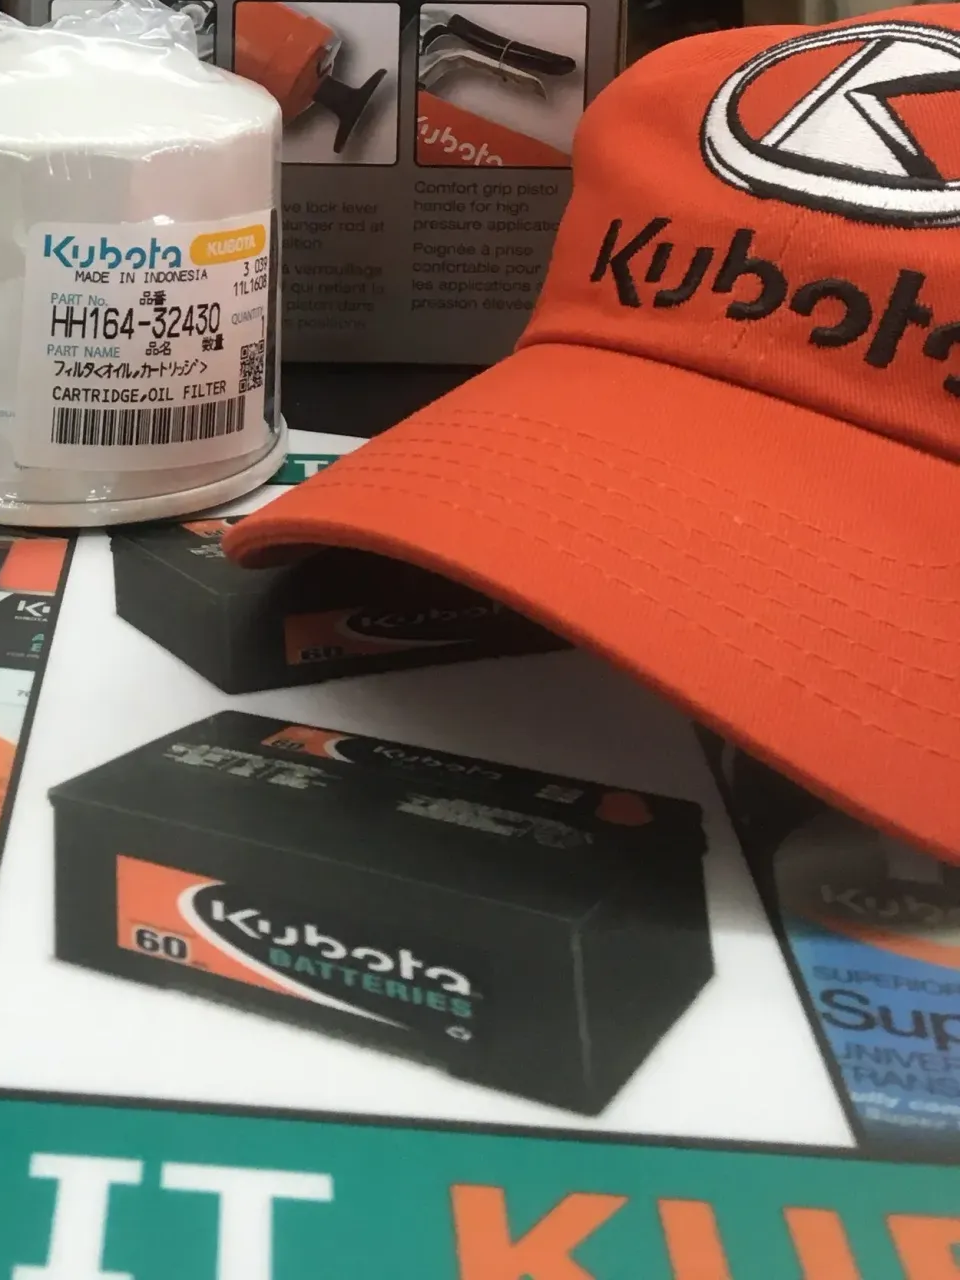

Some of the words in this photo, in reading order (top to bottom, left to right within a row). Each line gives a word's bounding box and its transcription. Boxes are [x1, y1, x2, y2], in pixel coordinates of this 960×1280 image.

[414, 181, 478, 194] Comfort
[483, 183, 512, 197] grip
[517, 183, 559, 196] pistol
[470, 201, 492, 212] for
[497, 201, 529, 216] high
[413, 220, 482, 232] pressure
[44, 234, 182, 269] Kubota
[207, 234, 257, 257] KUBOTA
[413, 242, 476, 258] Poignée
[75, 270, 110, 284] MADE
[120, 271, 136, 284] IN
[144, 269, 208, 283] INDONESIA
[506, 264, 542, 276] pour
[51, 293, 82, 305] PART
[88, 295, 108, 307] No.
[51, 302, 221, 340] HH164-32430
[47, 344, 78, 358] PART
[84, 346, 120, 358] NAME
[183, 380, 227, 399] FILTER
[133, 927, 190, 961] 60
[211, 899, 472, 996] Kubota
[268, 947, 472, 1018] BATTERIES
[12, 1153, 334, 1280] IT
